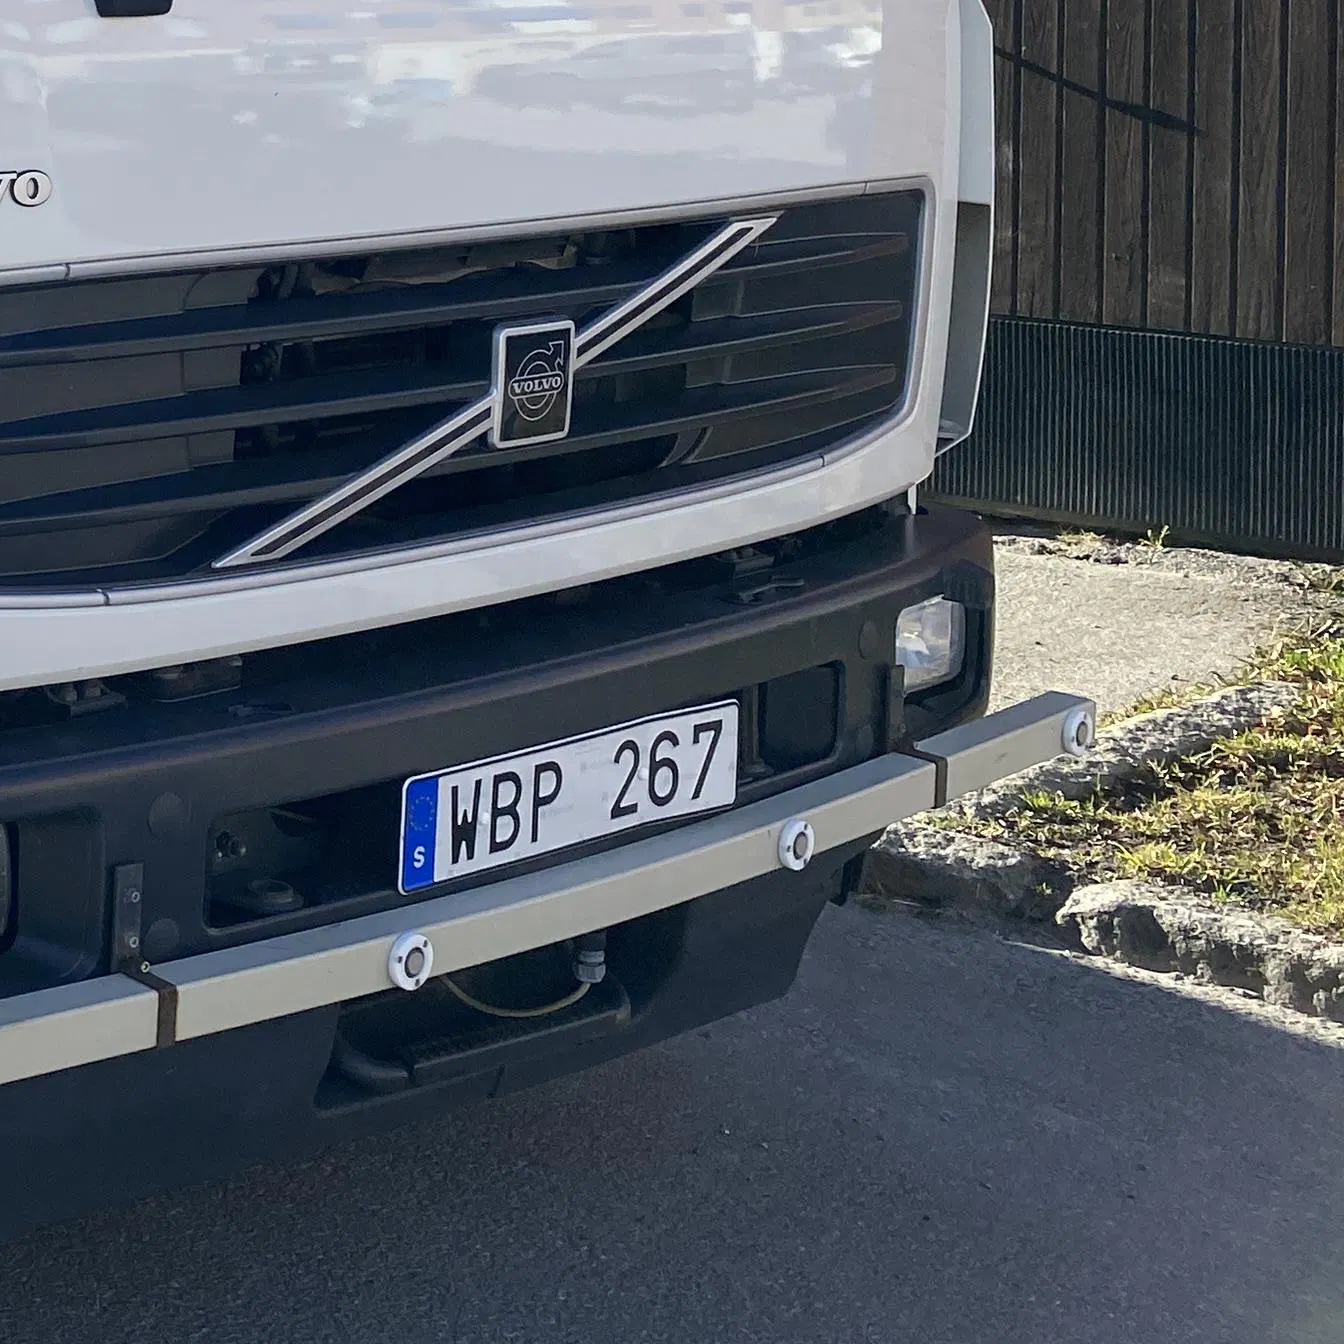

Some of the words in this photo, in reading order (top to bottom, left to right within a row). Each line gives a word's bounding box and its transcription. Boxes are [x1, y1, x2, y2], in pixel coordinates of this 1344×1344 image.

[512, 376, 561, 394] VOLVO
[413, 846, 425, 869] S
[451, 760, 563, 865] WBP
[611, 719, 723, 821] 267
